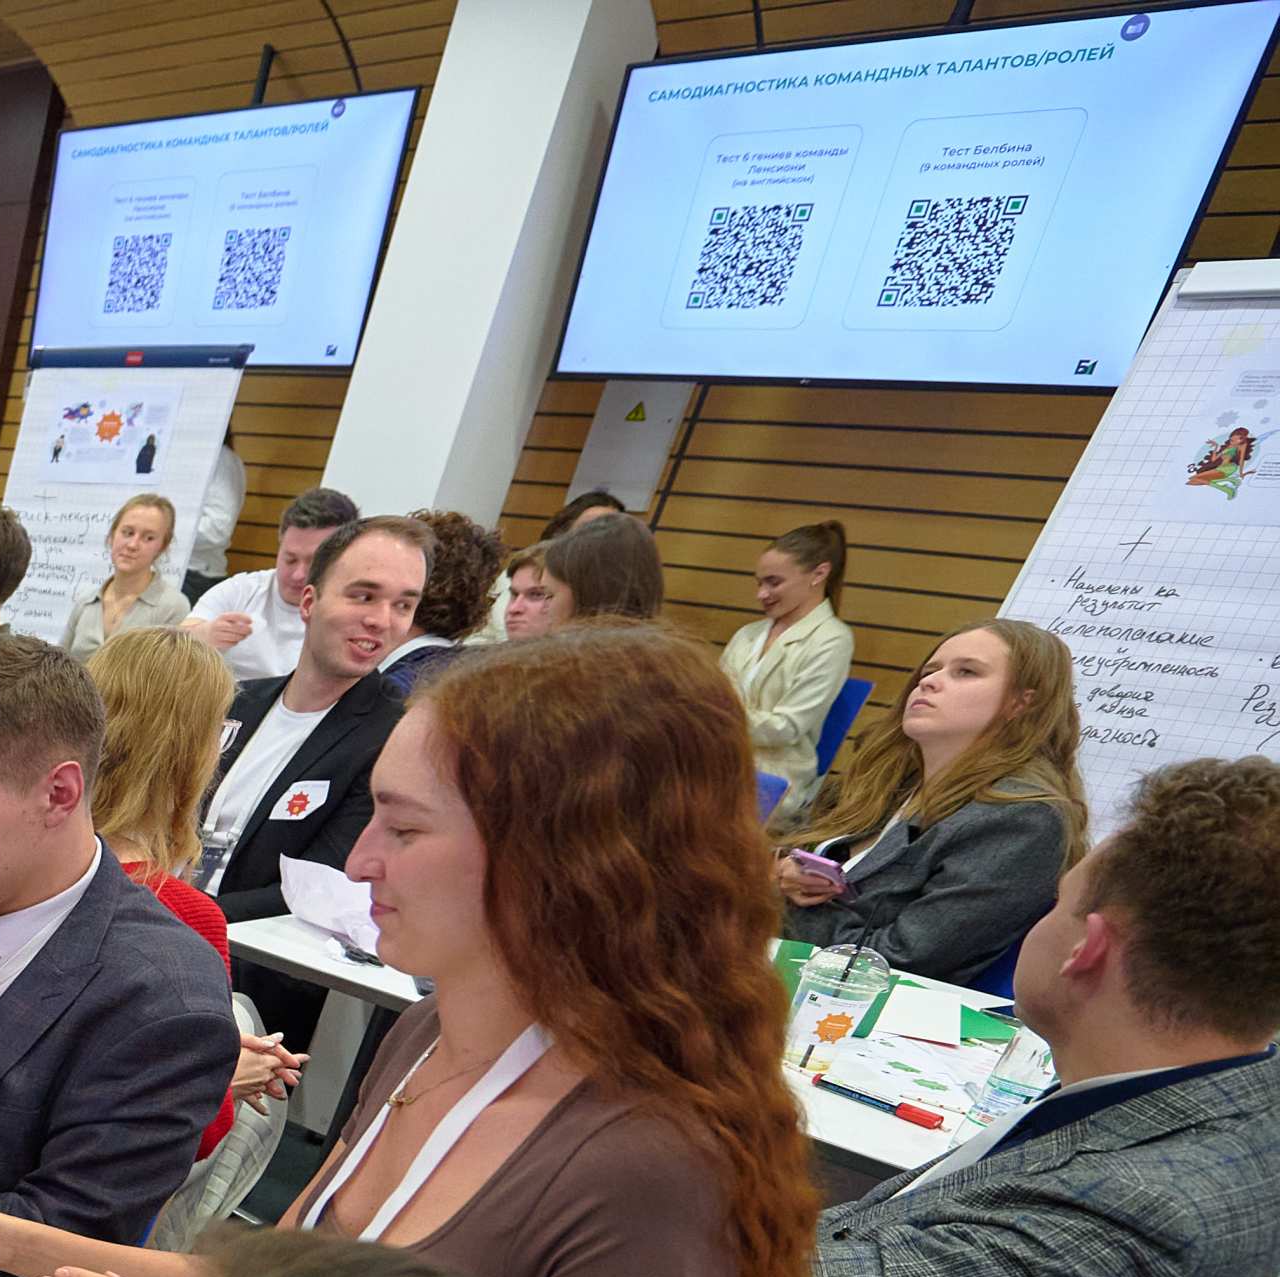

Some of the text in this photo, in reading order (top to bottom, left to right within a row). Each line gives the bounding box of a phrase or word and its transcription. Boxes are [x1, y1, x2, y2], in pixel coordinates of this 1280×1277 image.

[648, 44, 1115, 103] САМОДИАГНОСТИКА КОМАНДНЫХ ТАЛАНТОВ/РОЛЕЙ
[942, 142, 1033, 158] Тест Белбина
[934, 159, 1000, 172] командных
[1002, 156, 1045, 170] ролей)
[1072, 654, 1220, 678] леустремленность
